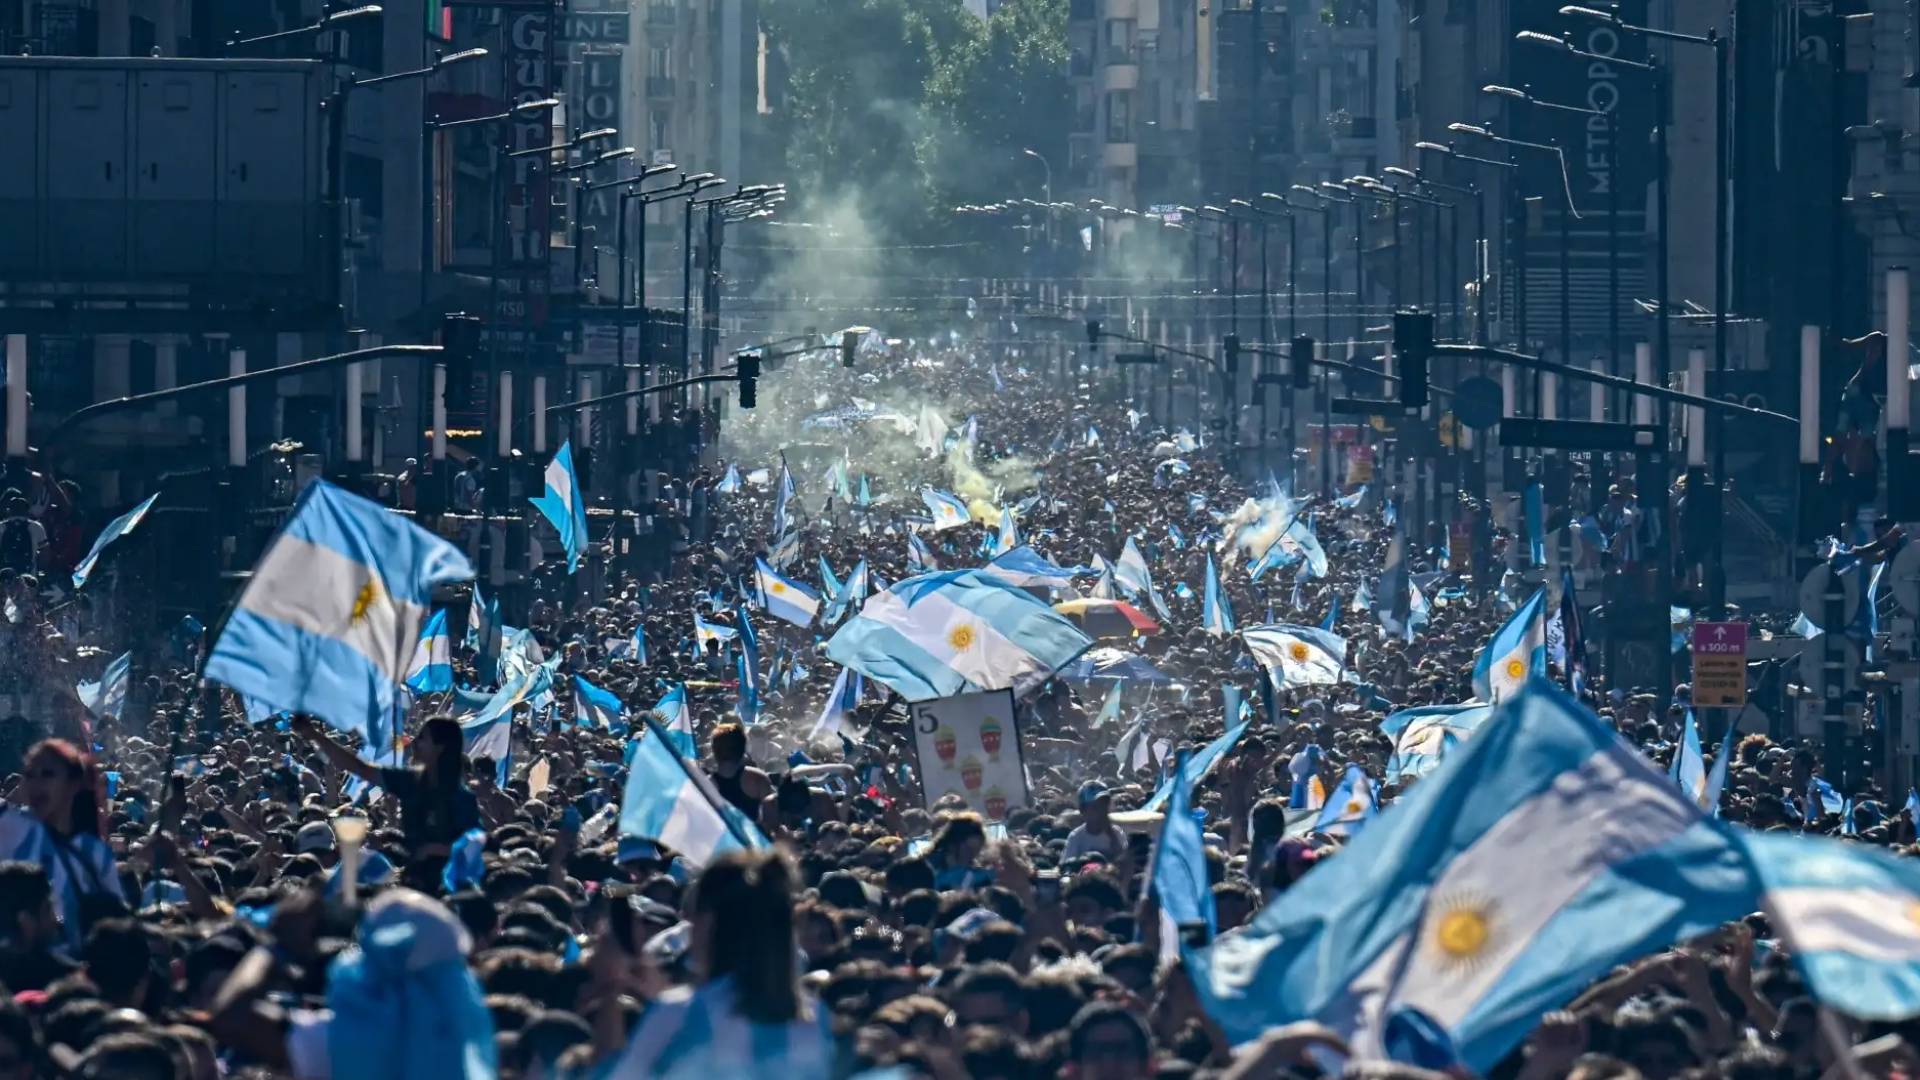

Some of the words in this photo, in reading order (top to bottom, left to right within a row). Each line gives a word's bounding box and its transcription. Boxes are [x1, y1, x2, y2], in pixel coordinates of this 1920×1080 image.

[553, 18, 622, 38] INE
[511, 14, 547, 260] Guerrn
[918, 706, 938, 734] 5
